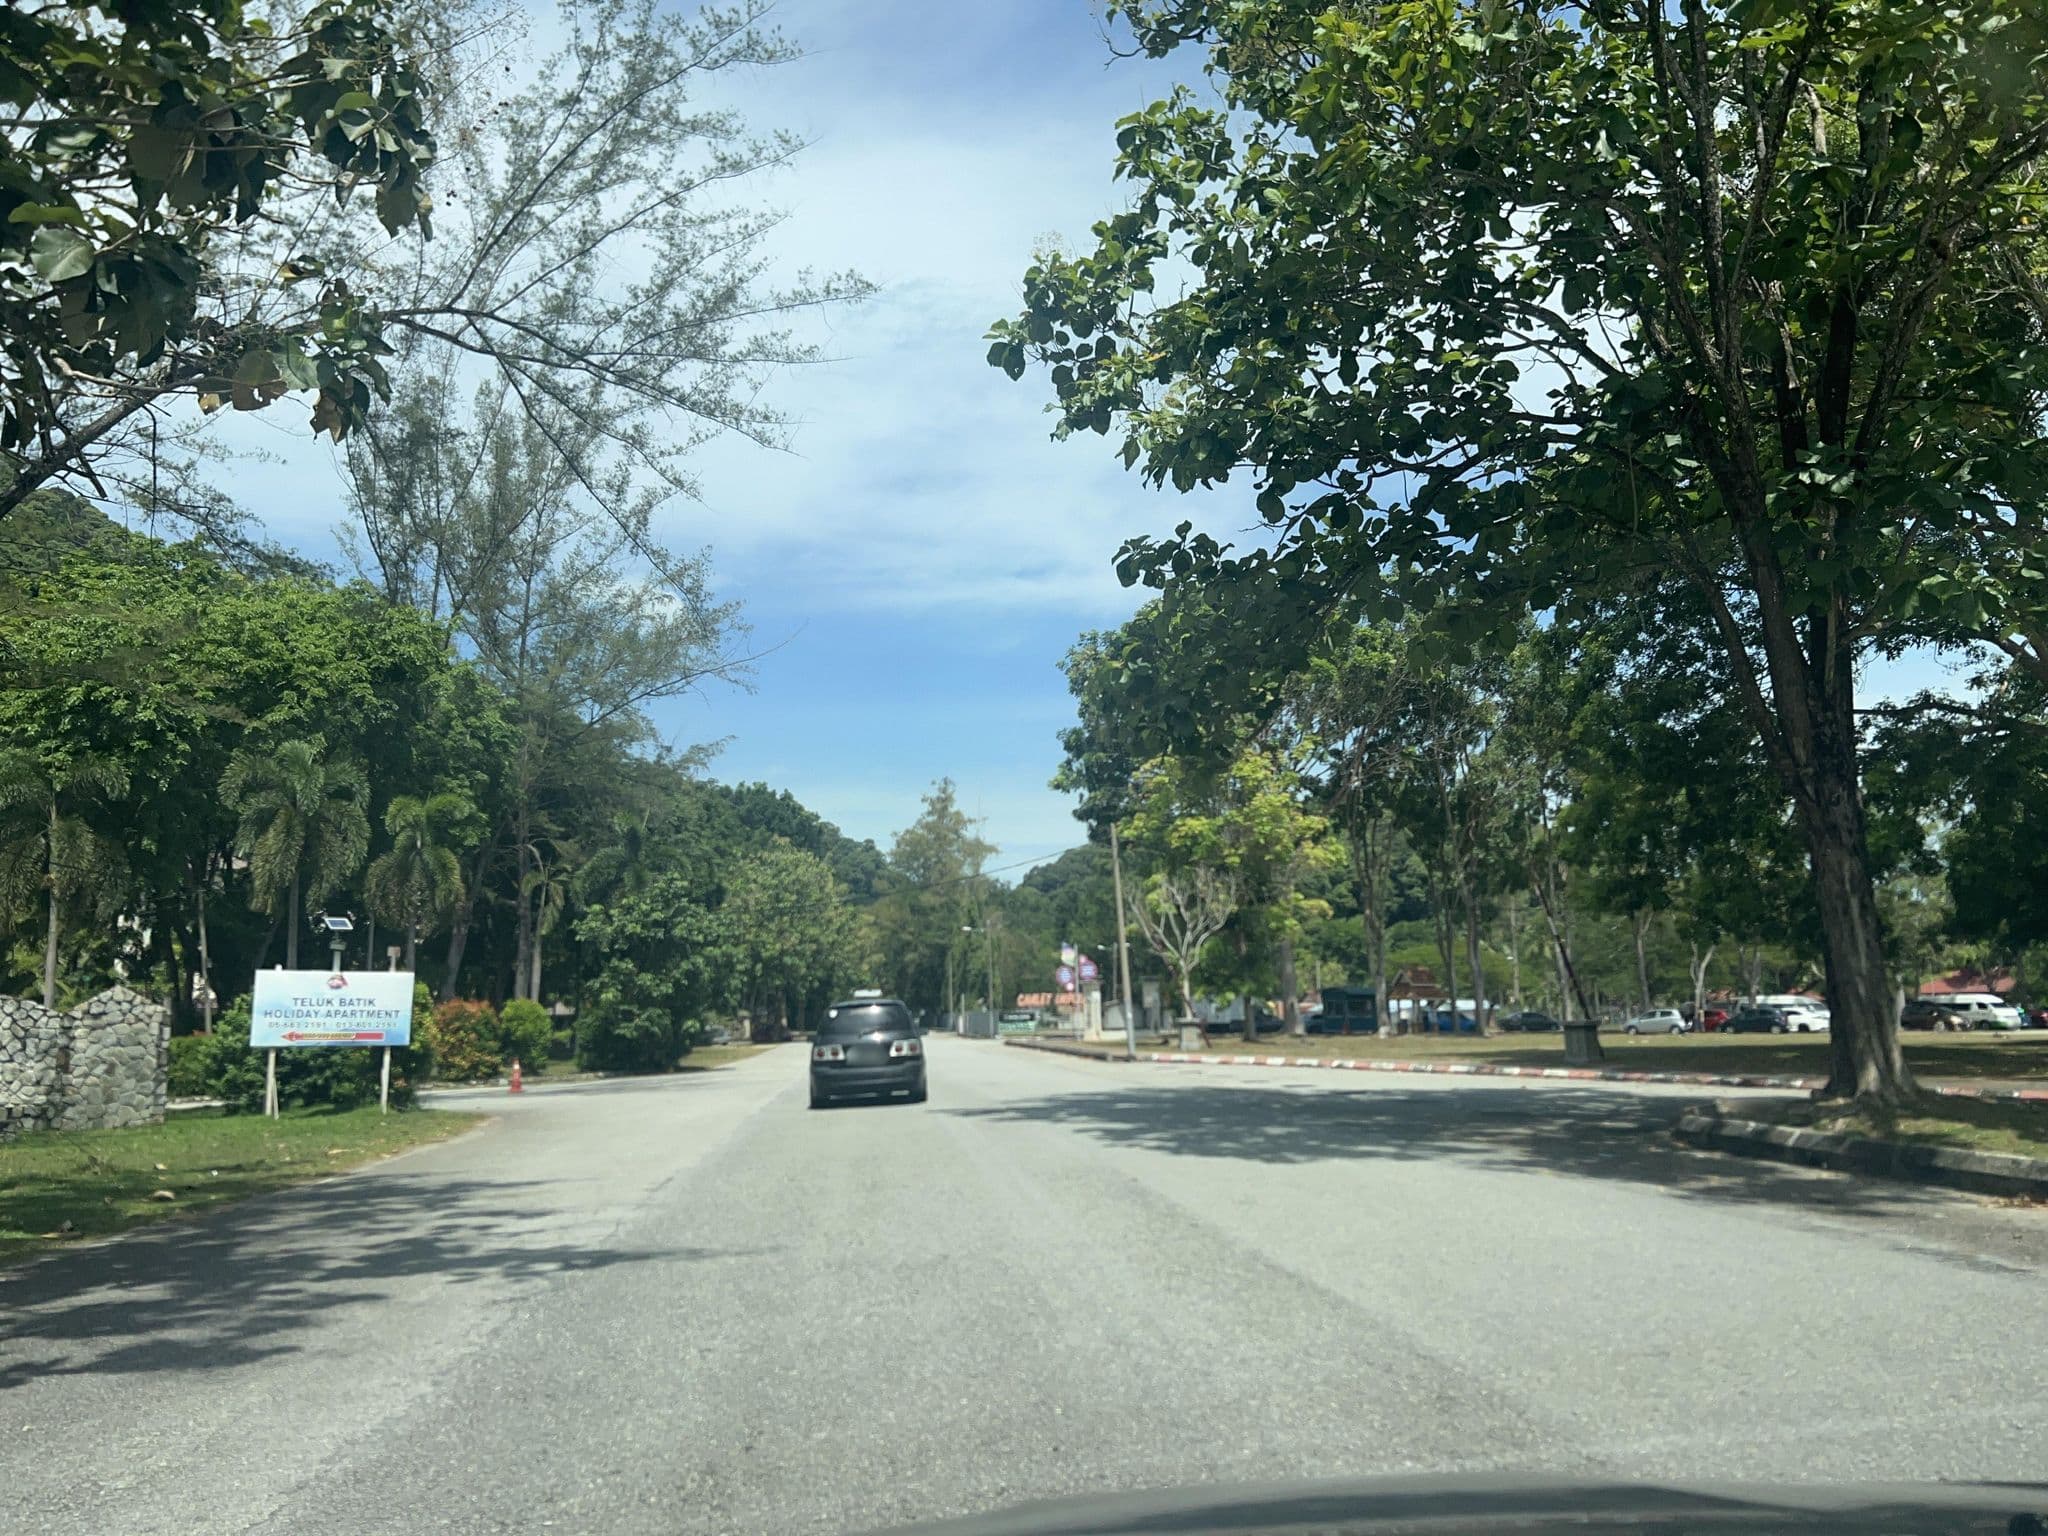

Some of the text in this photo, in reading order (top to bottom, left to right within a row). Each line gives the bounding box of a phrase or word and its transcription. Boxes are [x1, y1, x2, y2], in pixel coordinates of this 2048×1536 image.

[293, 997, 376, 1007] TELUK BATIK
[264, 1009, 400, 1019] HOLIDAY APARTMENT
